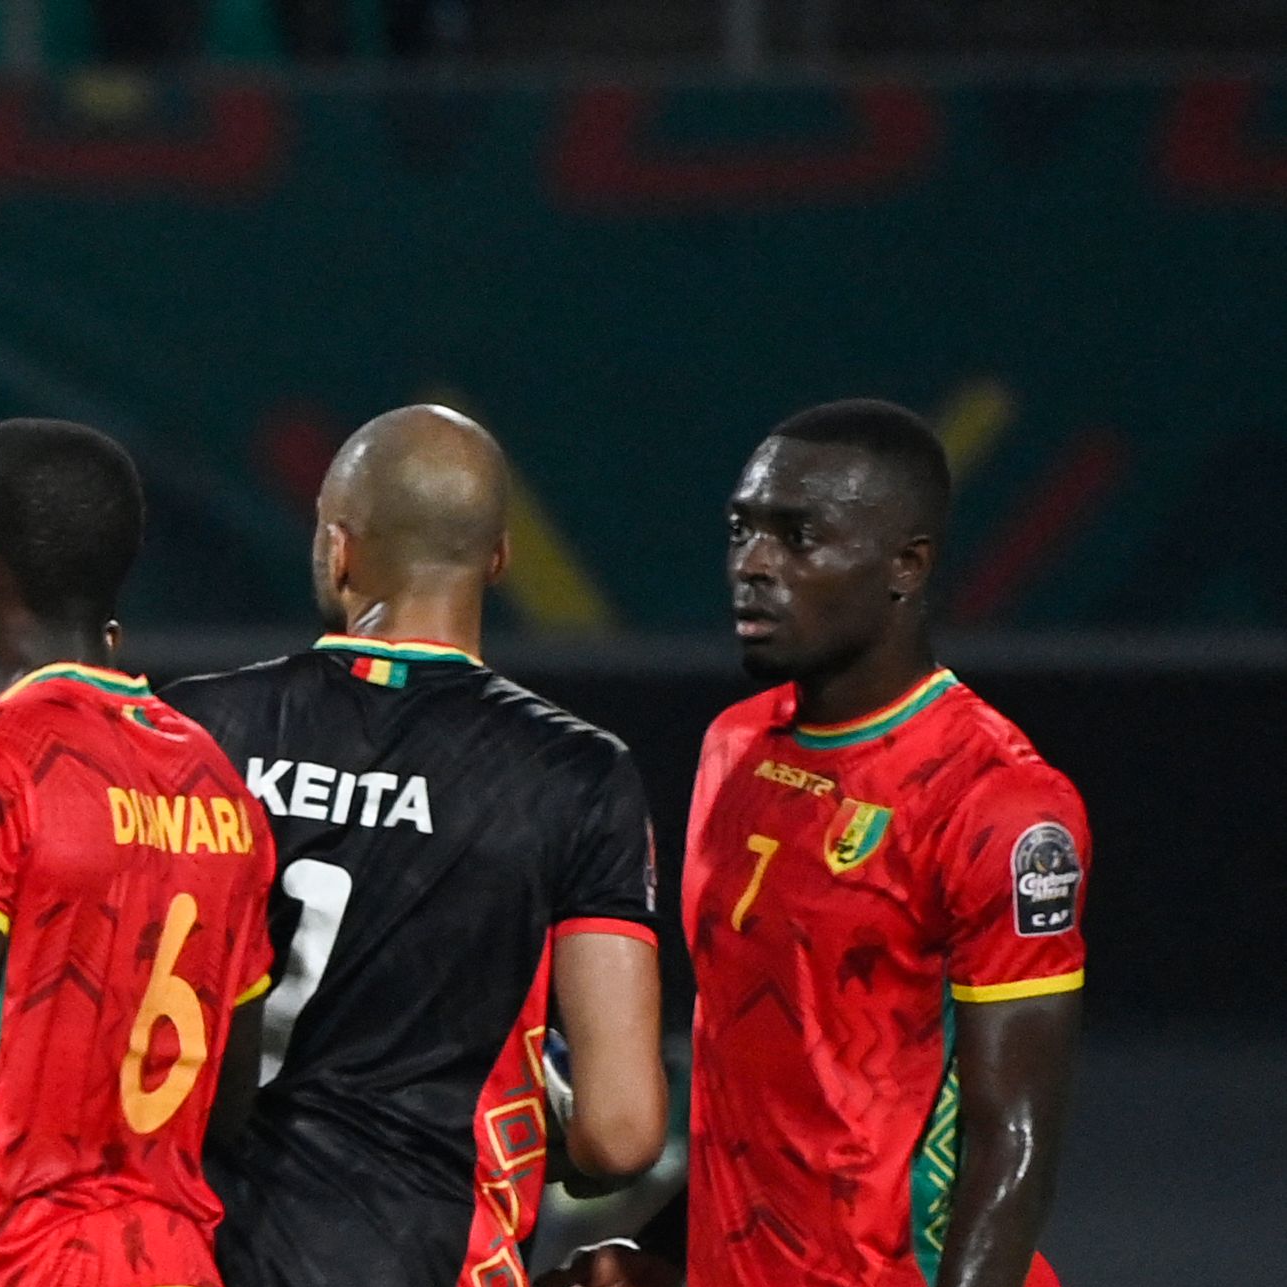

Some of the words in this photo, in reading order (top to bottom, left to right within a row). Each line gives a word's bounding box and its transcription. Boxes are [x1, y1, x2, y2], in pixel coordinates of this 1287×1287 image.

[246, 757, 434, 834] KEITA
[730, 833, 780, 932] 7
[120, 892, 208, 1134] 6
